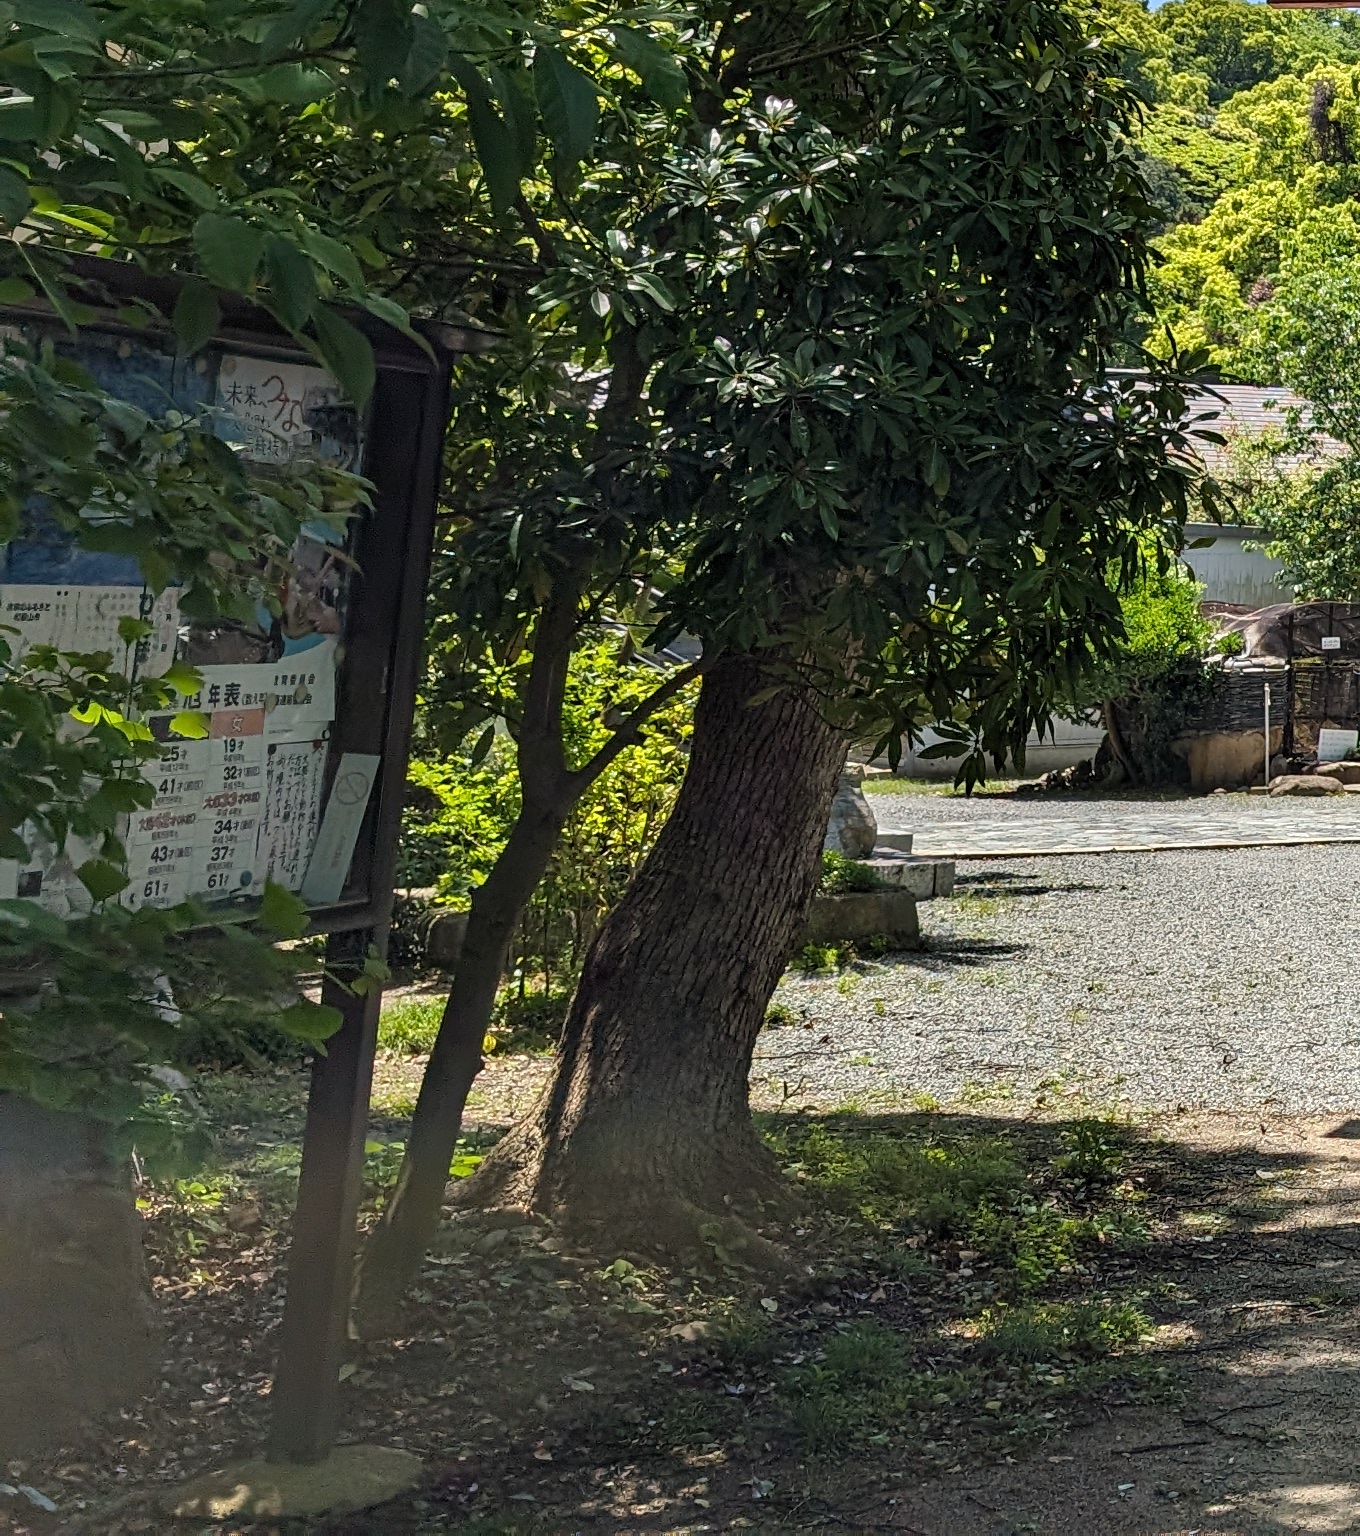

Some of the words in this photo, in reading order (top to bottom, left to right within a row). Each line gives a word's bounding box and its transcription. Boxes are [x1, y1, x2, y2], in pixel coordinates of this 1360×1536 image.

[225, 381, 267, 408] 未来へ
[232, 716, 243, 732] 女
